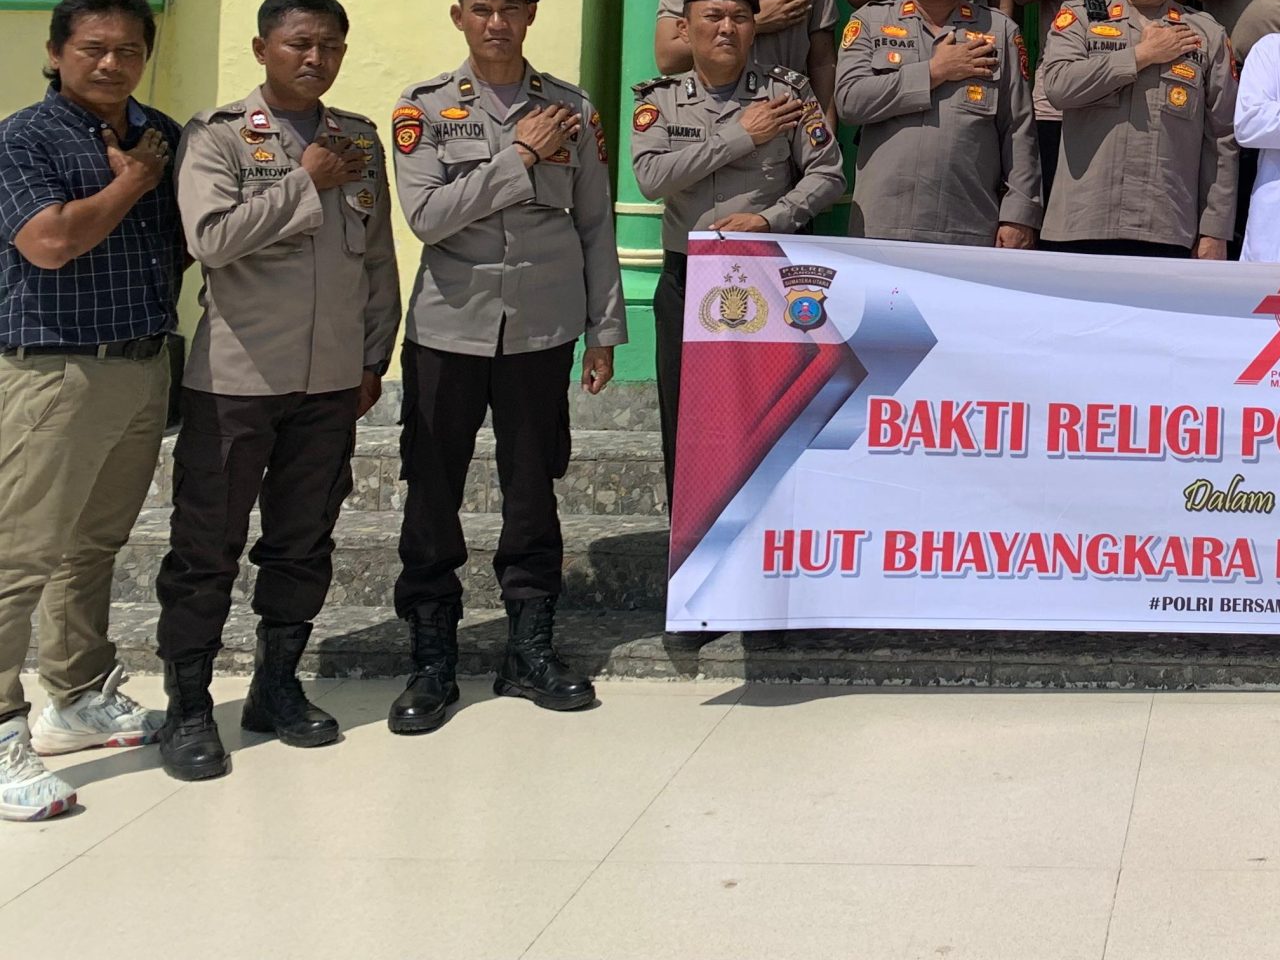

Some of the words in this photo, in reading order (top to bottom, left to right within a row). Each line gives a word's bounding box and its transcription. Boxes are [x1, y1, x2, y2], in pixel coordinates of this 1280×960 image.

[866, 396, 1028, 456] BAKTI
[1046, 402, 1222, 460] RELIGI
[1183, 474, 1275, 513] Dalam
[761, 528, 869, 576] HUT
[881, 530, 1260, 581] BHAYANGKARA
[1148, 595, 1214, 614] #POLRI
